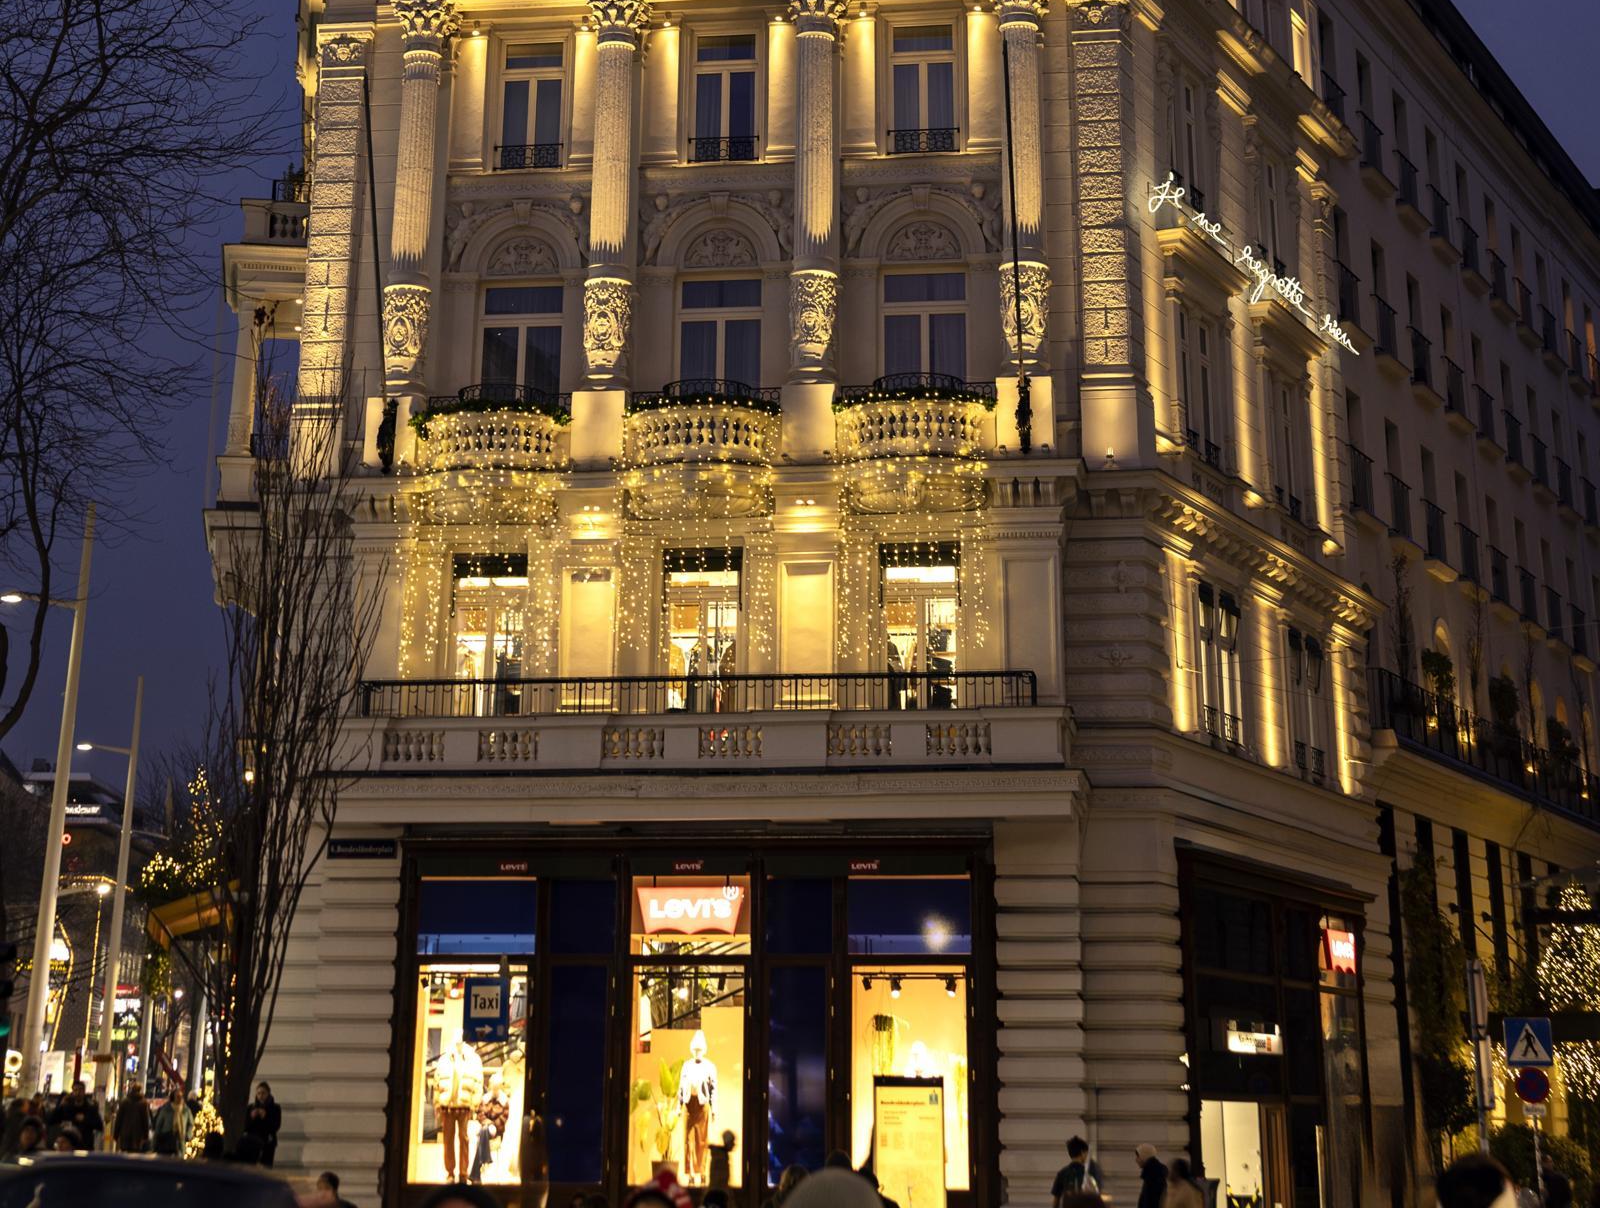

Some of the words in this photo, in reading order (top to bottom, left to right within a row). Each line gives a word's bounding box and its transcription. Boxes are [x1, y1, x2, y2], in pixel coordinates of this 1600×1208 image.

[1191, 212, 1227, 246] ne
[1235, 245, 1312, 317] regrette
[1320, 314, 1360, 356] rien
[472, 993, 499, 1010] Taxi
